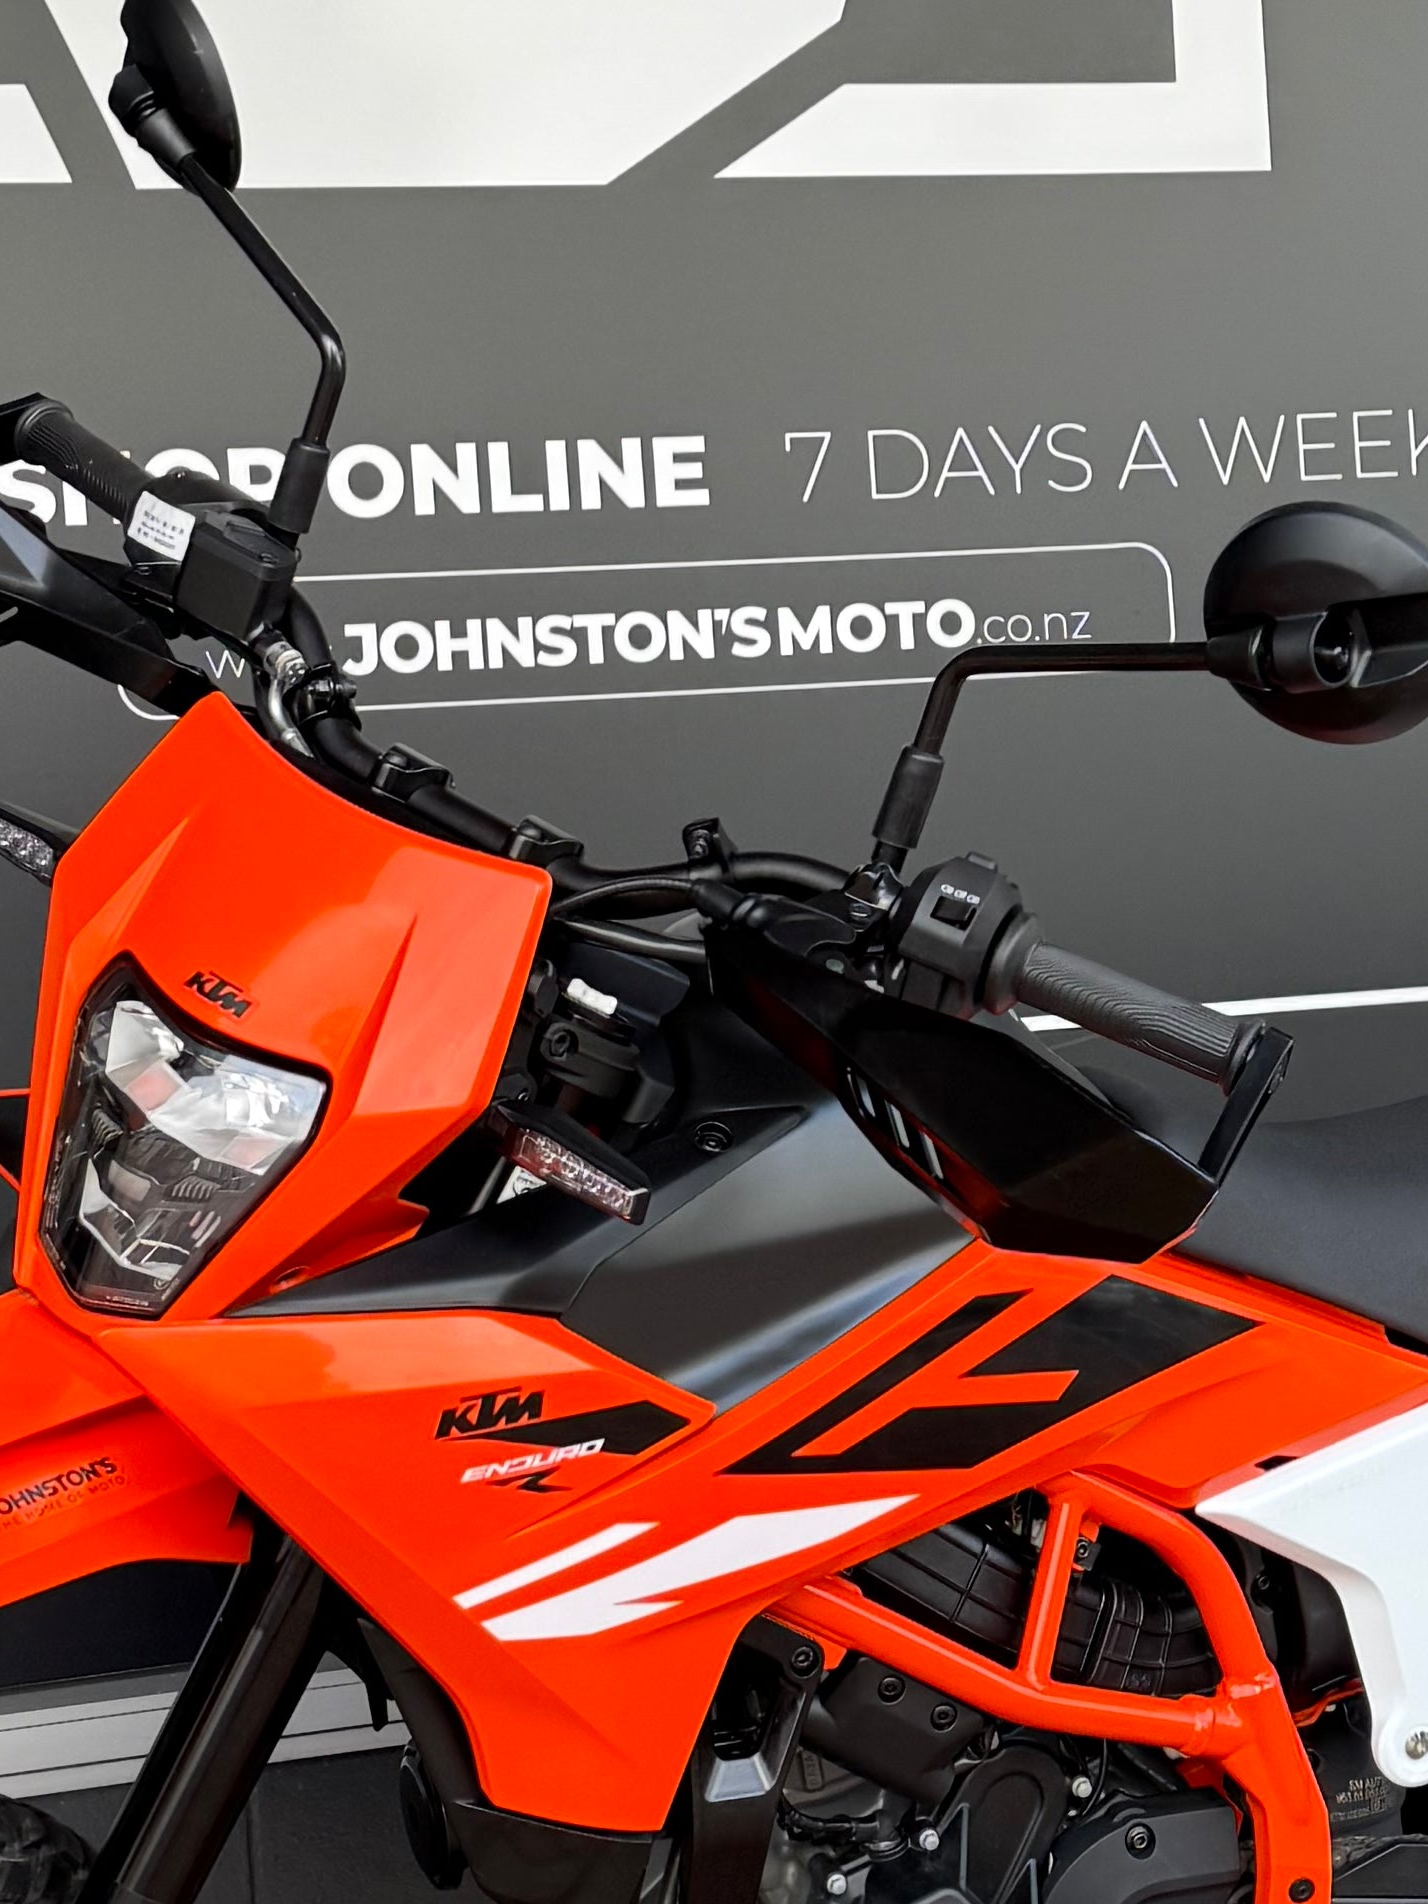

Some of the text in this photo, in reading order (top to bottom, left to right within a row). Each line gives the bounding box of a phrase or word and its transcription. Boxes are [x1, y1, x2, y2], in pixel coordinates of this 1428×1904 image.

[327, 436, 710, 519] ONLINE
[784, 431, 832, 503] 7
[867, 423, 1093, 500] DAYS
[1118, 419, 1179, 491] A
[183, 970, 252, 1018] KTM
[434, 1385, 546, 1440] KTM
[460, 1438, 605, 1483] ENDURO
